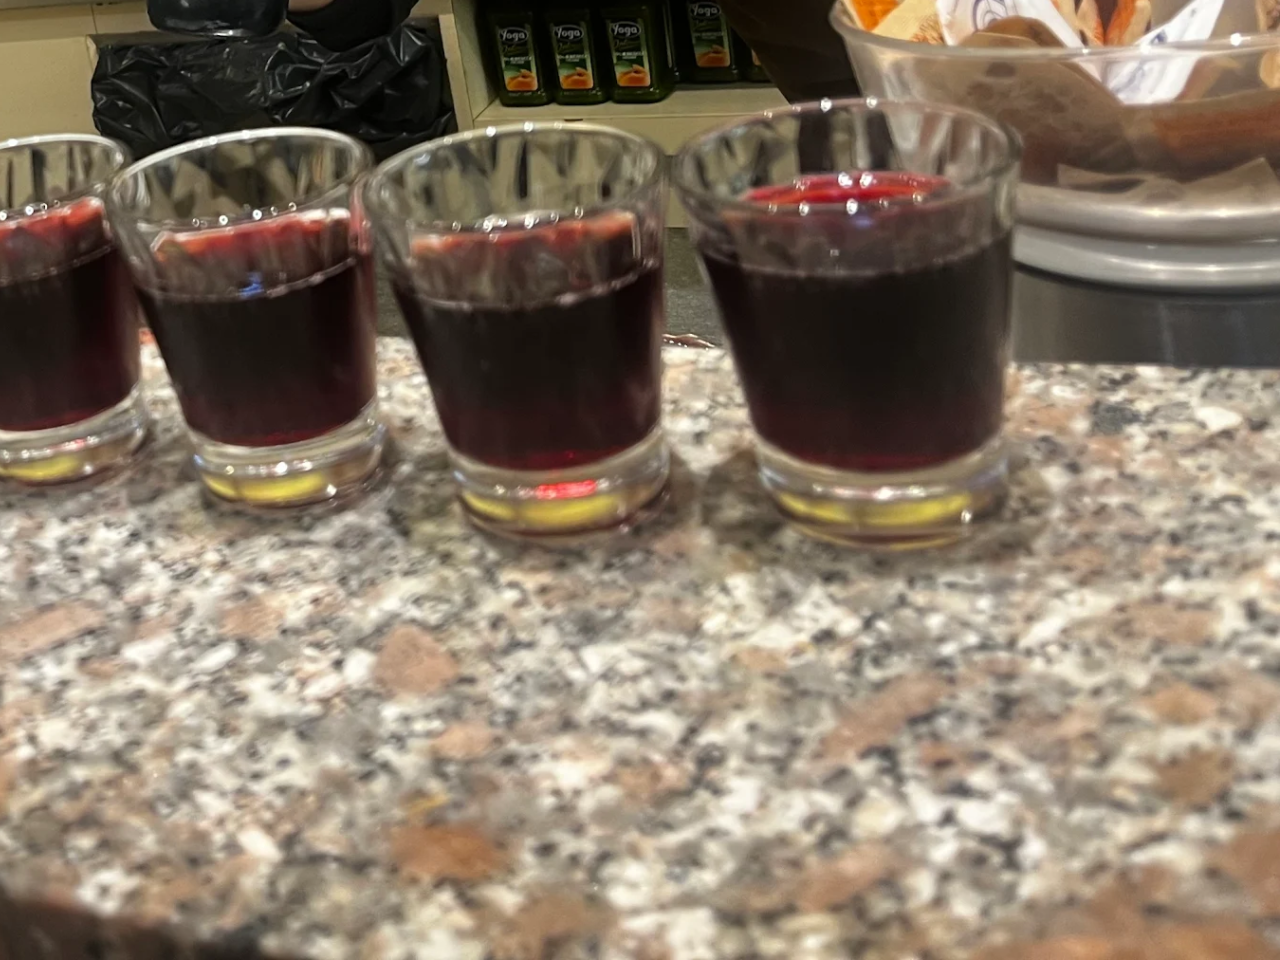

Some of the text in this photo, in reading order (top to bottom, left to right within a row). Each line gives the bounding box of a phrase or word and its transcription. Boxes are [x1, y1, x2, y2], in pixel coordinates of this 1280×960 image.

[500, 29, 526, 41] Yoga
[555, 26, 581, 39] Yoga
[610, 22, 638, 36] Yoga
